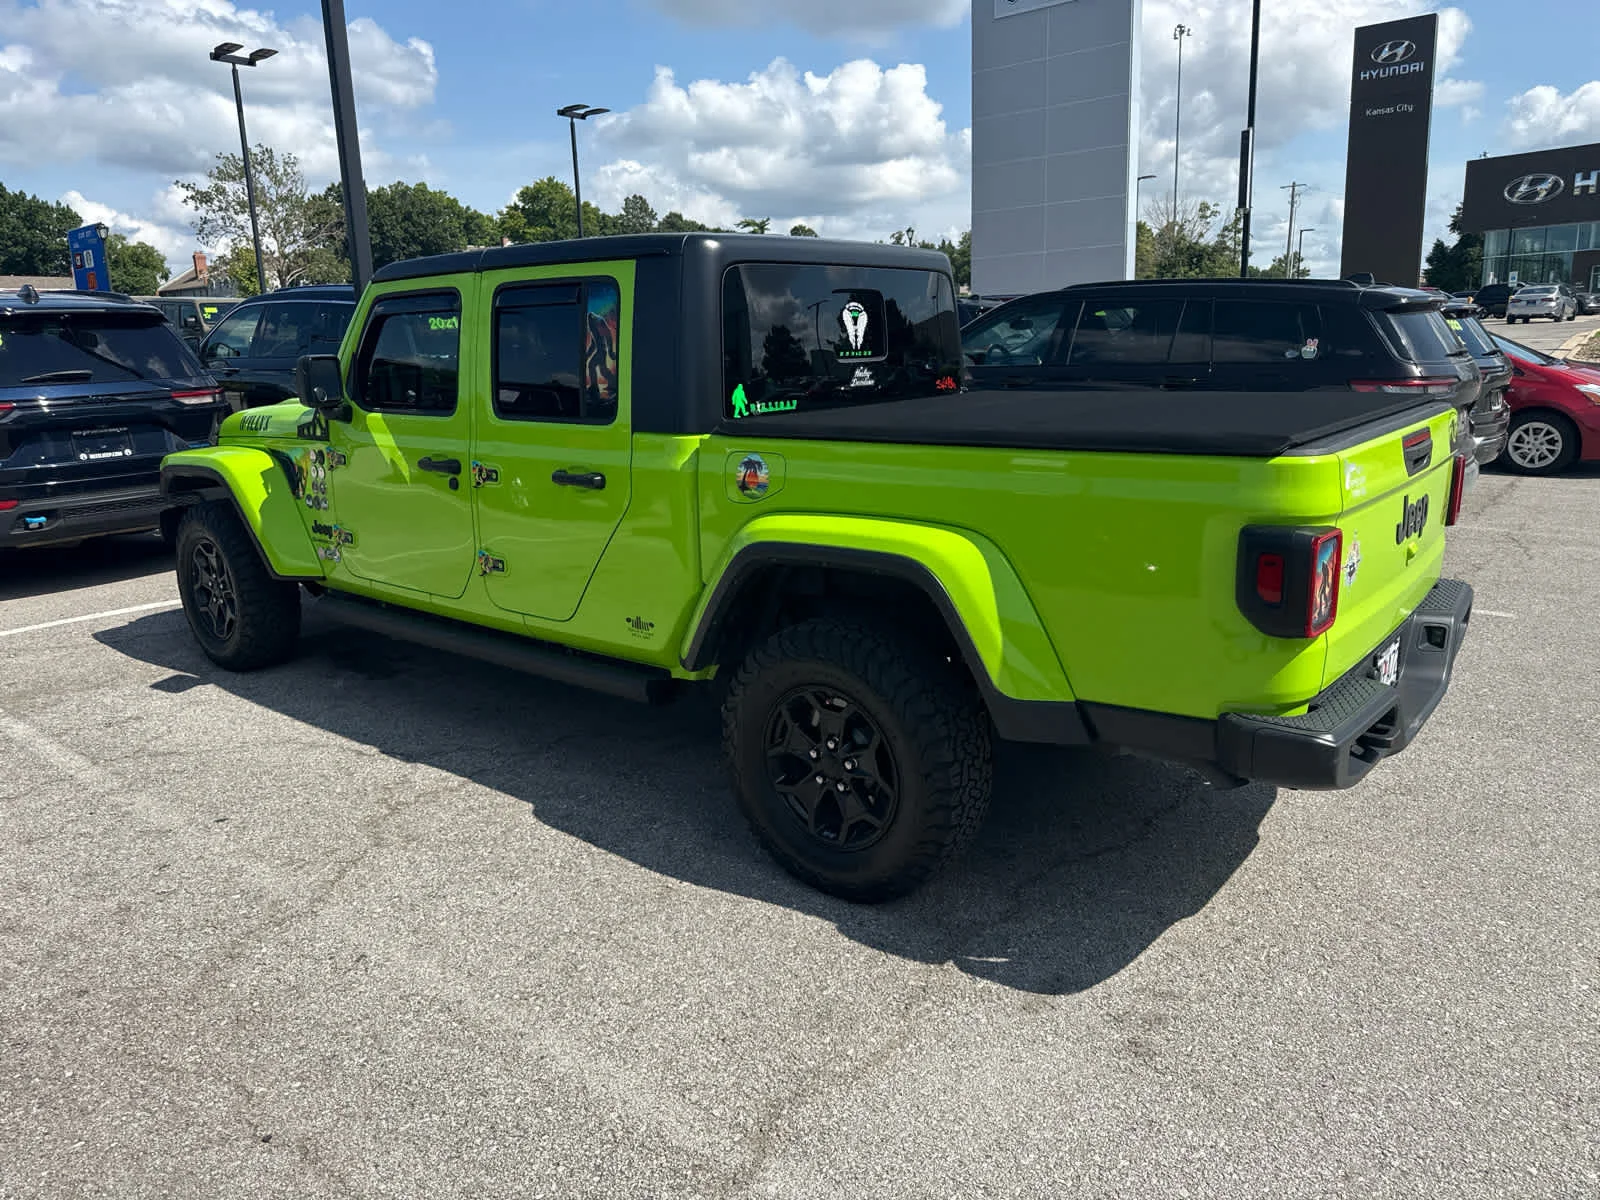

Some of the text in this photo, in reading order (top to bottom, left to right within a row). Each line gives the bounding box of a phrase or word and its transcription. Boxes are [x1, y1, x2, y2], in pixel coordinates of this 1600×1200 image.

[1360, 62, 1424, 80] HYUNDAI
[1366, 103, 1414, 116] Kansas City
[1573, 170, 1600, 196] H
[428, 316, 458, 329] 2021
[1396, 493, 1429, 545] Jeep
